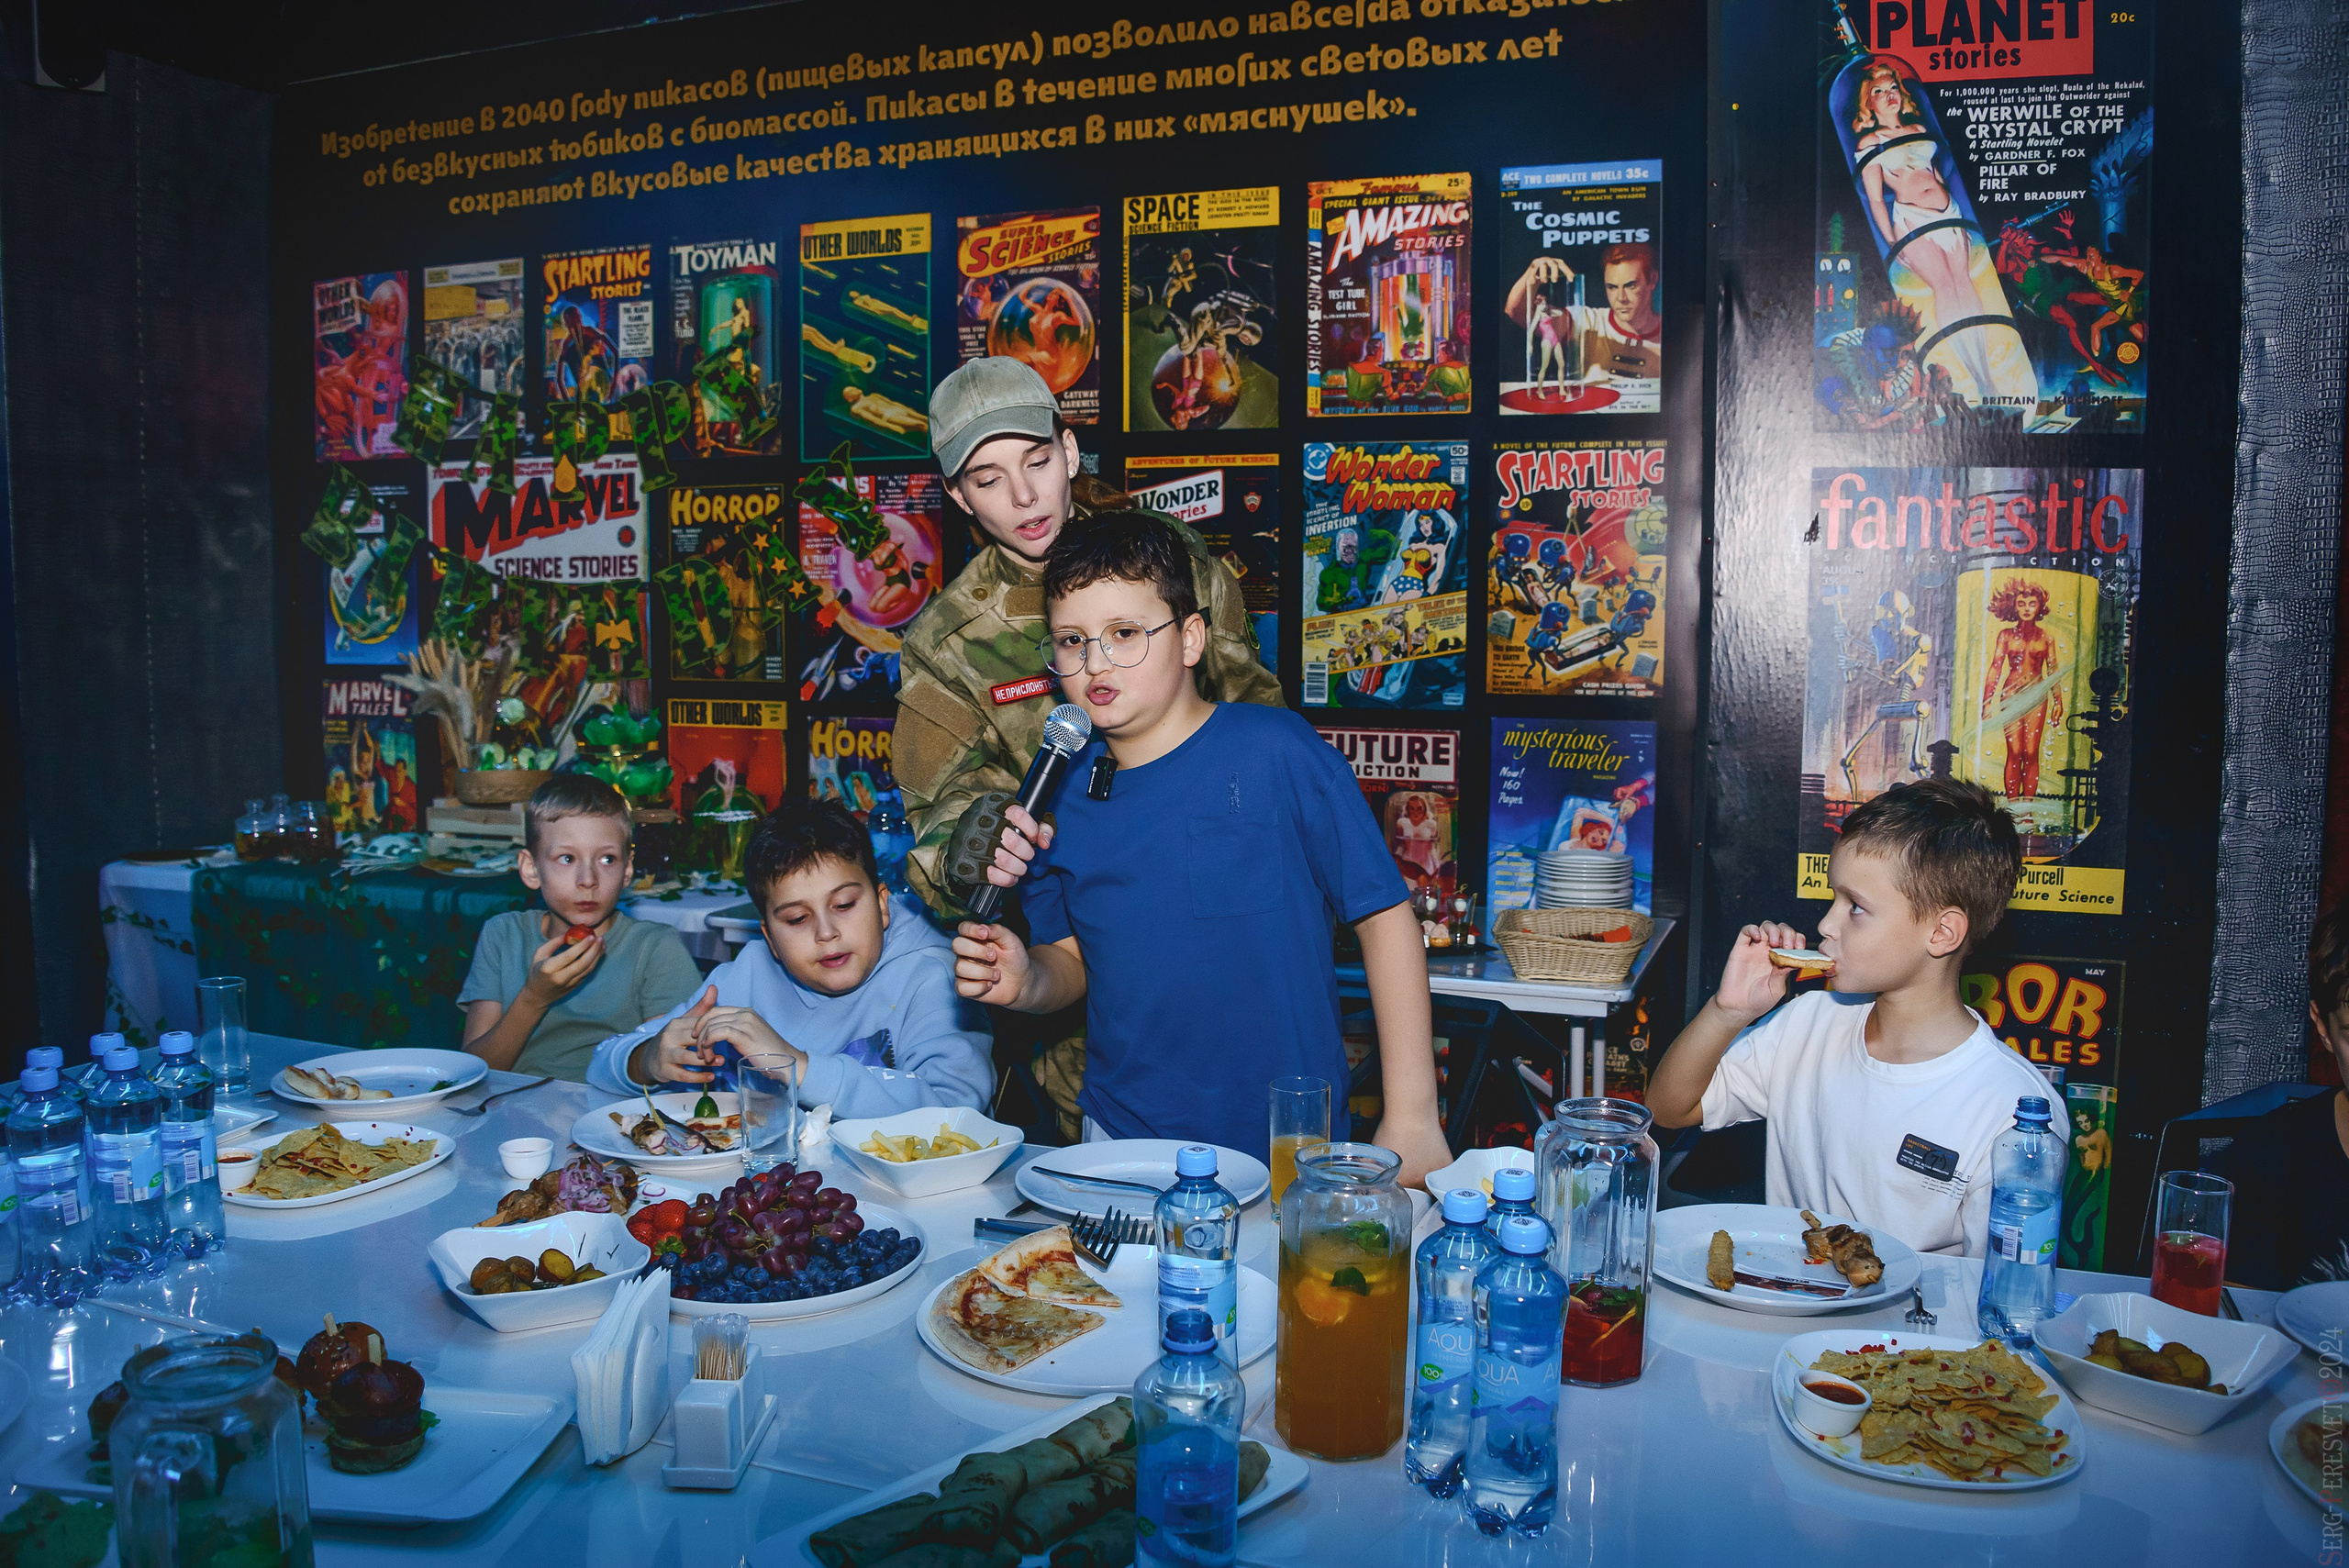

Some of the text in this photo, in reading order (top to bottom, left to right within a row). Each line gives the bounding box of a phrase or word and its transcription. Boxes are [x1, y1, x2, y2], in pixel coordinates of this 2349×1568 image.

[1877, 0, 2087, 49] PLANET
[1929, 43, 2021, 71] stories
[321, 117, 474, 159] Изобретение
[502, 99, 564, 128] 2040
[572, 89, 628, 121] году
[634, 70, 747, 109] пикасов
[757, 52, 911, 98] (пищевых
[919, 31, 1044, 72] капсул)
[1053, 17, 1240, 58] позволило
[1249, 0, 1412, 35] навсегда
[1940, 89, 1953, 97] For
[1956, 87, 1996, 96] 1,000,000
[1998, 86, 2020, 96] years
[2023, 85, 2036, 94] she
[2086, 83, 2095, 91] of
[2098, 82, 2110, 90] the
[1963, 96, 1987, 105] roused
[2000, 95, 2015, 104] last
[2028, 95, 2042, 104] join
[2044, 94, 2057, 102] the
[2059, 93, 2101, 101] Outworlder
[2104, 91, 2131, 100] against
[363, 162, 387, 187] от
[393, 147, 543, 185] безвкусных
[670, 126, 685, 147] с
[690, 100, 857, 145] биомассой.
[867, 89, 987, 122] Пикасы
[1022, 72, 1157, 105] течение
[1166, 51, 1292, 90] многих
[1301, 37, 1488, 77] световых
[1497, 28, 1563, 61] лет
[1946, 104, 2124, 122] the WERWILE OF THE
[1965, 118, 2124, 139] CRYSTAL CRYPT
[448, 176, 585, 216] сохраняют
[591, 161, 729, 200] вкусовые
[737, 140, 872, 181] качества
[879, 126, 1077, 169] хранящихся
[1115, 116, 1176, 141] них
[1184, 89, 1418, 134] «мяснушек».
[1969, 137, 2065, 150] A Startling Novelet
[1969, 148, 2086, 161] by GARDNER F. FOX
[1501, 172, 1520, 181] ACE
[1523, 174, 1542, 184] TWO
[1545, 172, 1587, 183] COMPLETE
[1590, 170, 1623, 181] NOVELS
[1979, 163, 2057, 177] PILLAR OF
[1979, 178, 2009, 191] FIRE
[1324, 194, 1420, 209] SPECIAL GIANT ISSUE
[1511, 201, 1543, 211] THE
[1979, 190, 2087, 204] by RAY BRADBURY
[1129, 195, 1199, 224] SPACE
[1129, 221, 1199, 235] SCIENCE FICTION
[1526, 210, 1620, 230] COSMIC
[999, 224, 1045, 239] SUPER
[1325, 201, 1470, 275] AMAZING
[1542, 228, 1651, 249] PUPPETS
[803, 228, 902, 260] OTHER WORLDS
[966, 229, 1076, 273] SCIENCE
[1048, 240, 1091, 264] STORIES
[1394, 234, 1466, 251] STORIES
[674, 241, 776, 275] TOYMAN
[543, 250, 651, 304] STARTLING
[590, 280, 642, 300] STORIES
[1328, 287, 1366, 300] TEST TUBE
[1335, 301, 1357, 312] GIRL
[1063, 390, 1100, 399] GATEWAY
[1982, 396, 2036, 406] BRITTAIN
[1060, 400, 1100, 409] DARKNESS
[1131, 458, 1185, 466] ADVENTURES
[1203, 456, 1237, 464] FUTURE
[1241, 455, 1275, 463] SCIENCE
[1326, 446, 1442, 484] Wonder
[1496, 448, 1665, 509] STARTLING
[1137, 479, 1219, 511] WONDER
[1342, 477, 1457, 514] Woman
[1569, 487, 1652, 509] STORIES
[432, 473, 640, 563] MARVEL
[1820, 473, 2130, 554] fantastic
[1305, 515, 1358, 537] INVERSION
[495, 555, 639, 580] SCIENCE STORIES
[328, 681, 408, 717] MARVEL
[995, 688, 1006, 700] НЕ
[351, 702, 391, 716] TALES
[671, 700, 763, 727] OTHER WORLDS
[1503, 728, 1608, 760] mysterious
[1549, 740, 1631, 772] traveler
[1499, 766, 1525, 778] Now!
[1502, 780, 1521, 790] 160
[1497, 792, 1523, 807] Pages
[1805, 856, 1828, 873] THE
[1802, 877, 1821, 888] An
[2019, 868, 2065, 886] Purcell
[2058, 889, 2116, 905] Science
[2085, 968, 2106, 976] MAY
[1428, 1328, 1474, 1356] AQU
[1476, 1359, 1520, 1386] QUA
